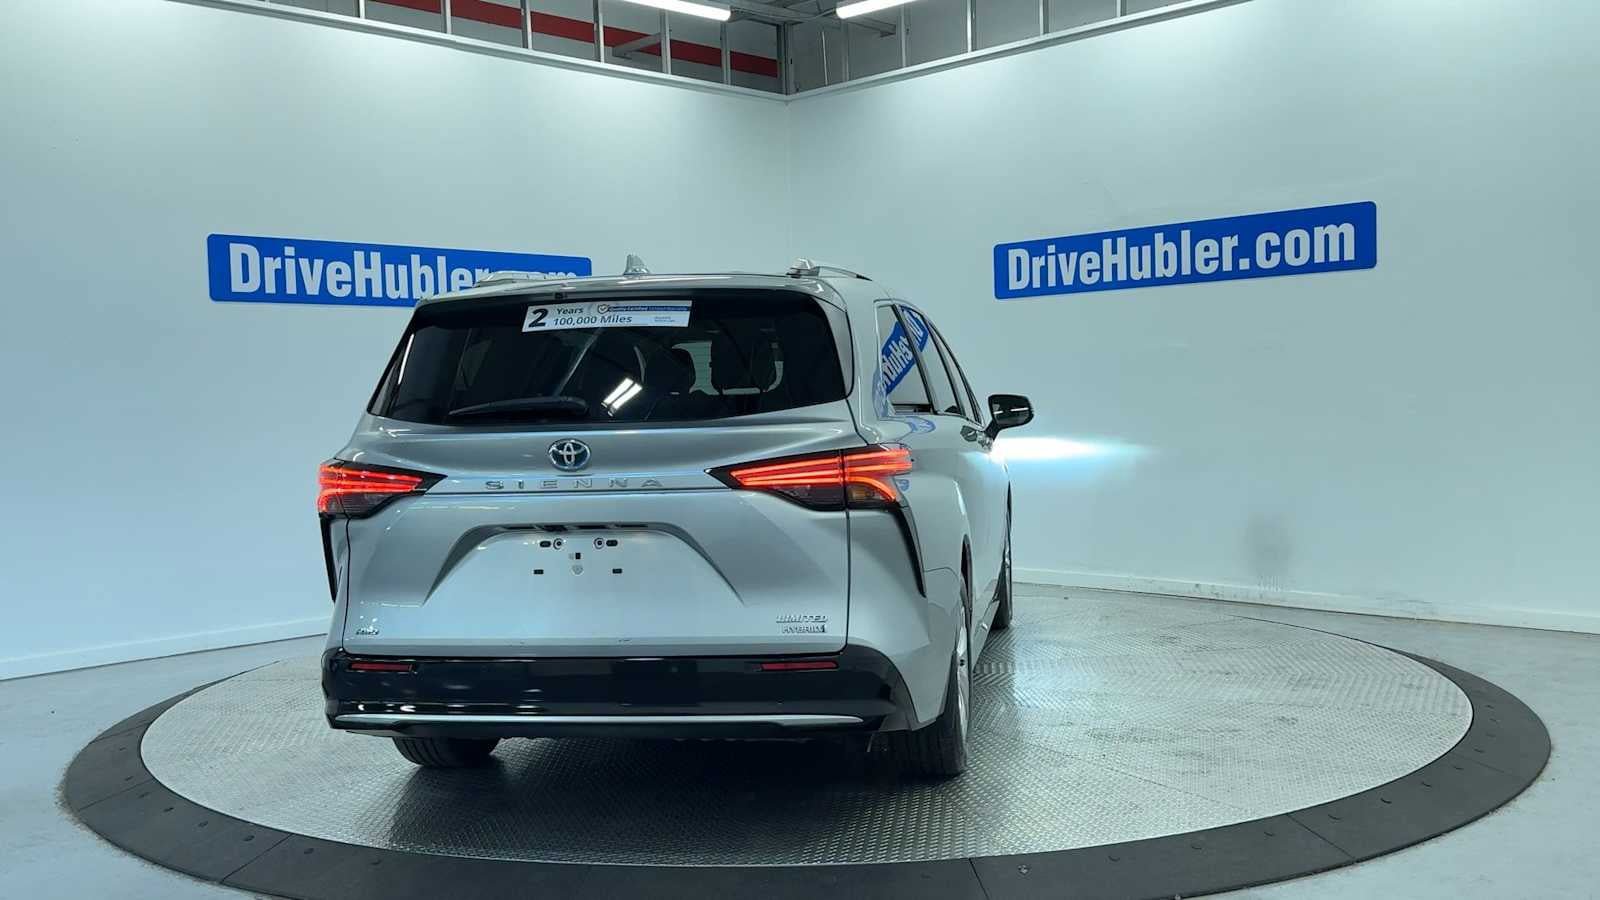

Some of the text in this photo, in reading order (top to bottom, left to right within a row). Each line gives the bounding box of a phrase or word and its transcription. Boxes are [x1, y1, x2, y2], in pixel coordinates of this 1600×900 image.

[1007, 221, 1355, 290] DriveHubler.com
[528, 307, 549, 328] 2
[556, 307, 584, 315] Years
[553, 314, 633, 327] 100,000 Miles
[485, 477, 663, 490] SIENNA
